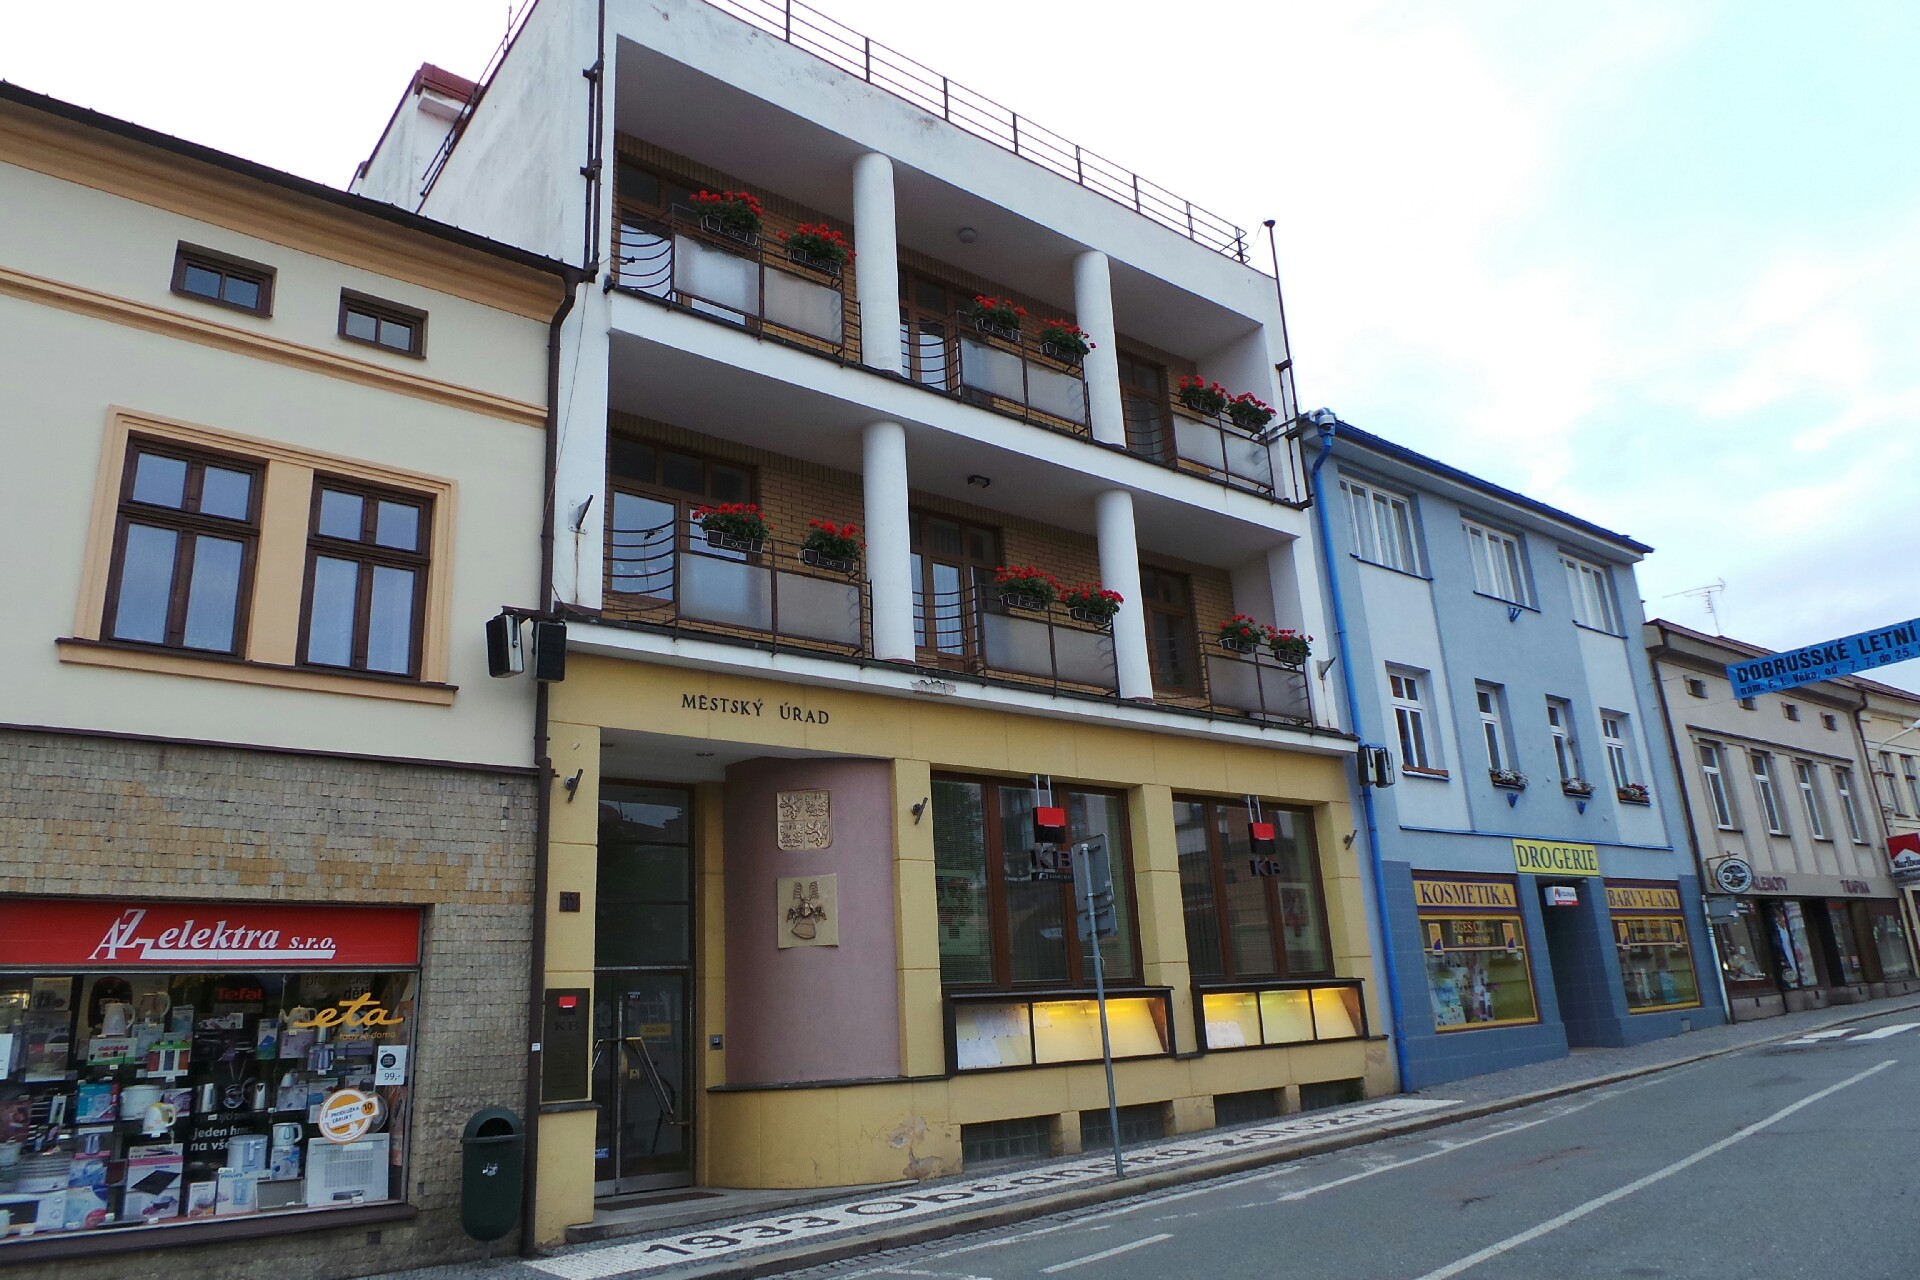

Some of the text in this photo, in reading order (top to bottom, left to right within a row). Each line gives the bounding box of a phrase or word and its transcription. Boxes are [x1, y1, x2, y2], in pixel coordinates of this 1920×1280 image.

[1736, 621, 1917, 684] DOBRUŠSKÉ LETNÍ
[1825, 664, 1838, 676] od
[1849, 660, 1860, 671] 7.
[1864, 657, 1875, 667] 7.
[1879, 652, 1892, 663] do
[1895, 647, 1915, 660] 25.
[1031, 849, 1073, 869] KB
[1250, 859, 1281, 877] KB
[1516, 844, 1597, 871] DROGERIE
[1419, 883, 1512, 905] KOSMETIKA
[158, 919, 280, 949] elektra
[289, 936, 336, 949] s.r.o.
[215, 987, 263, 1000] Tefal
[293, 992, 404, 1028] eta
[384, 1072, 401, 1081] 99,-
[362, 1102, 373, 1111] 10
[192, 1127, 227, 1141] jeden
[190, 1142, 208, 1152] na
[643, 1216, 841, 1256] 1933
